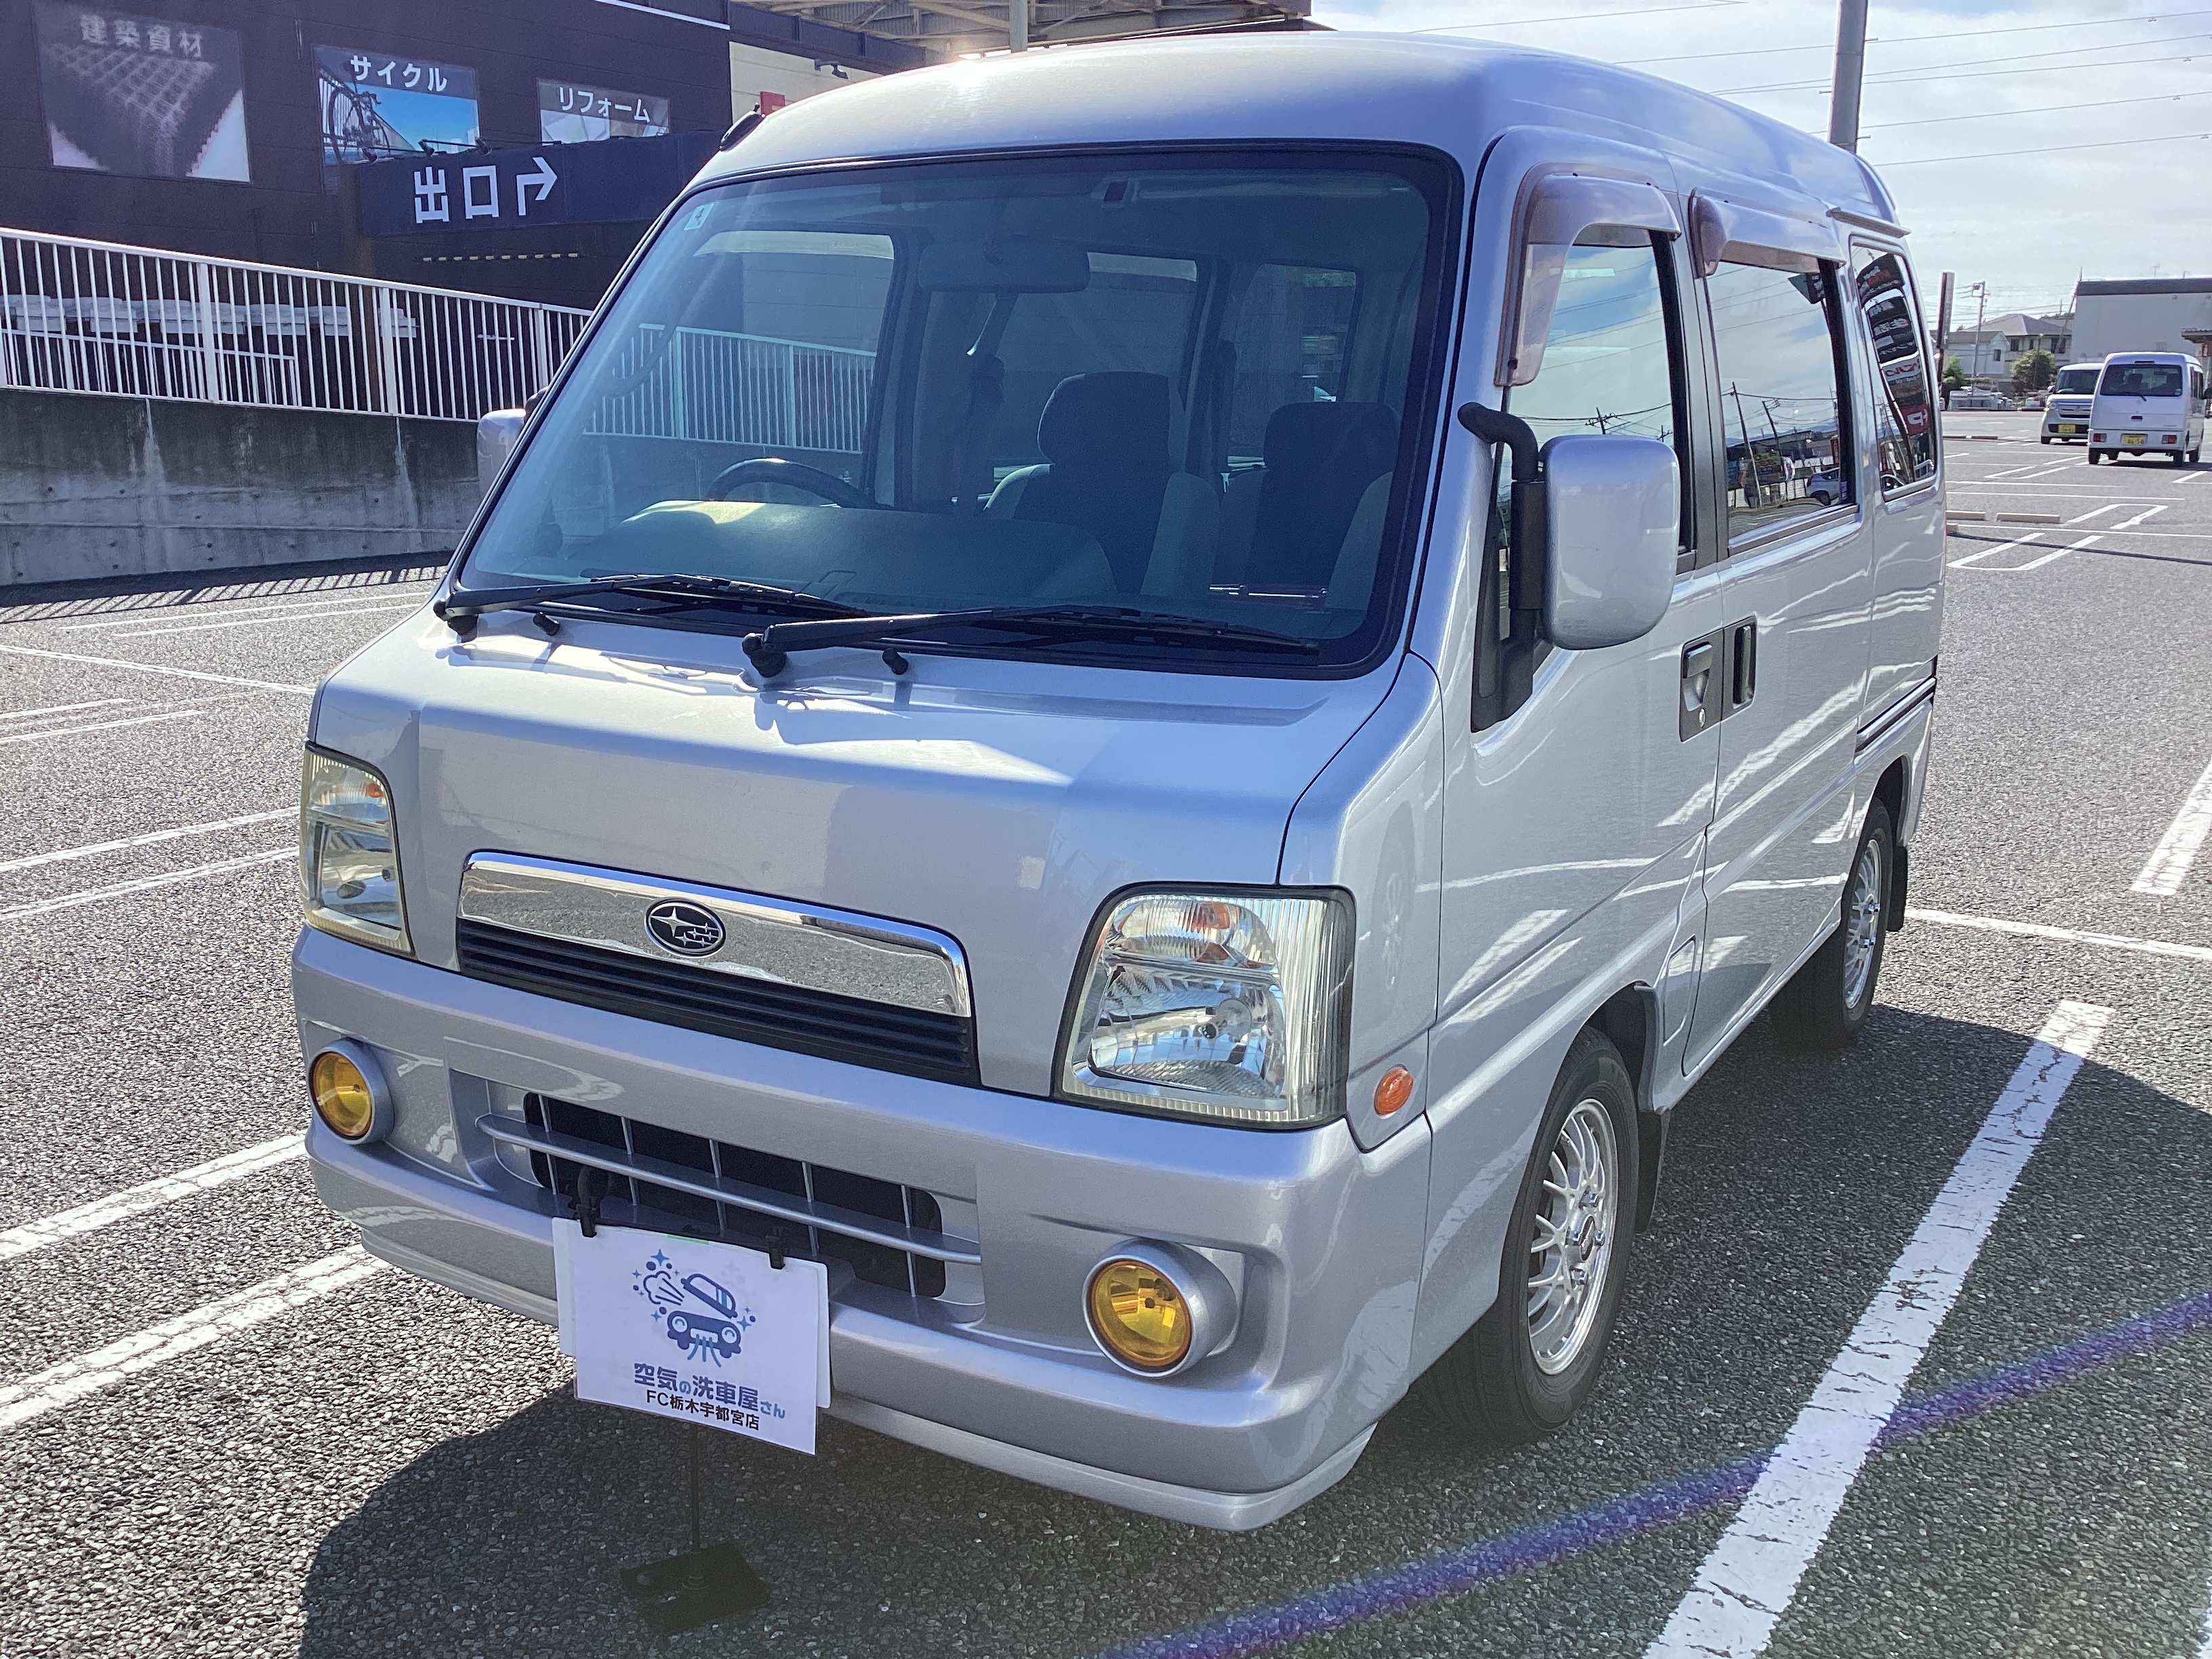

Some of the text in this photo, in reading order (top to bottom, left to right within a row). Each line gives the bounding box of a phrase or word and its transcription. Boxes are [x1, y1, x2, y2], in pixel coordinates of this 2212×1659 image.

[79, 14, 203, 59] 建築資材
[350, 54, 448, 94] サイクル
[558, 86, 651, 125] リフォーム
[413, 165, 501, 224] 出口
[634, 1362, 786, 1420] 空気の洗車屋さん
[646, 1389, 760, 1431] FC栃木宇都宮店
